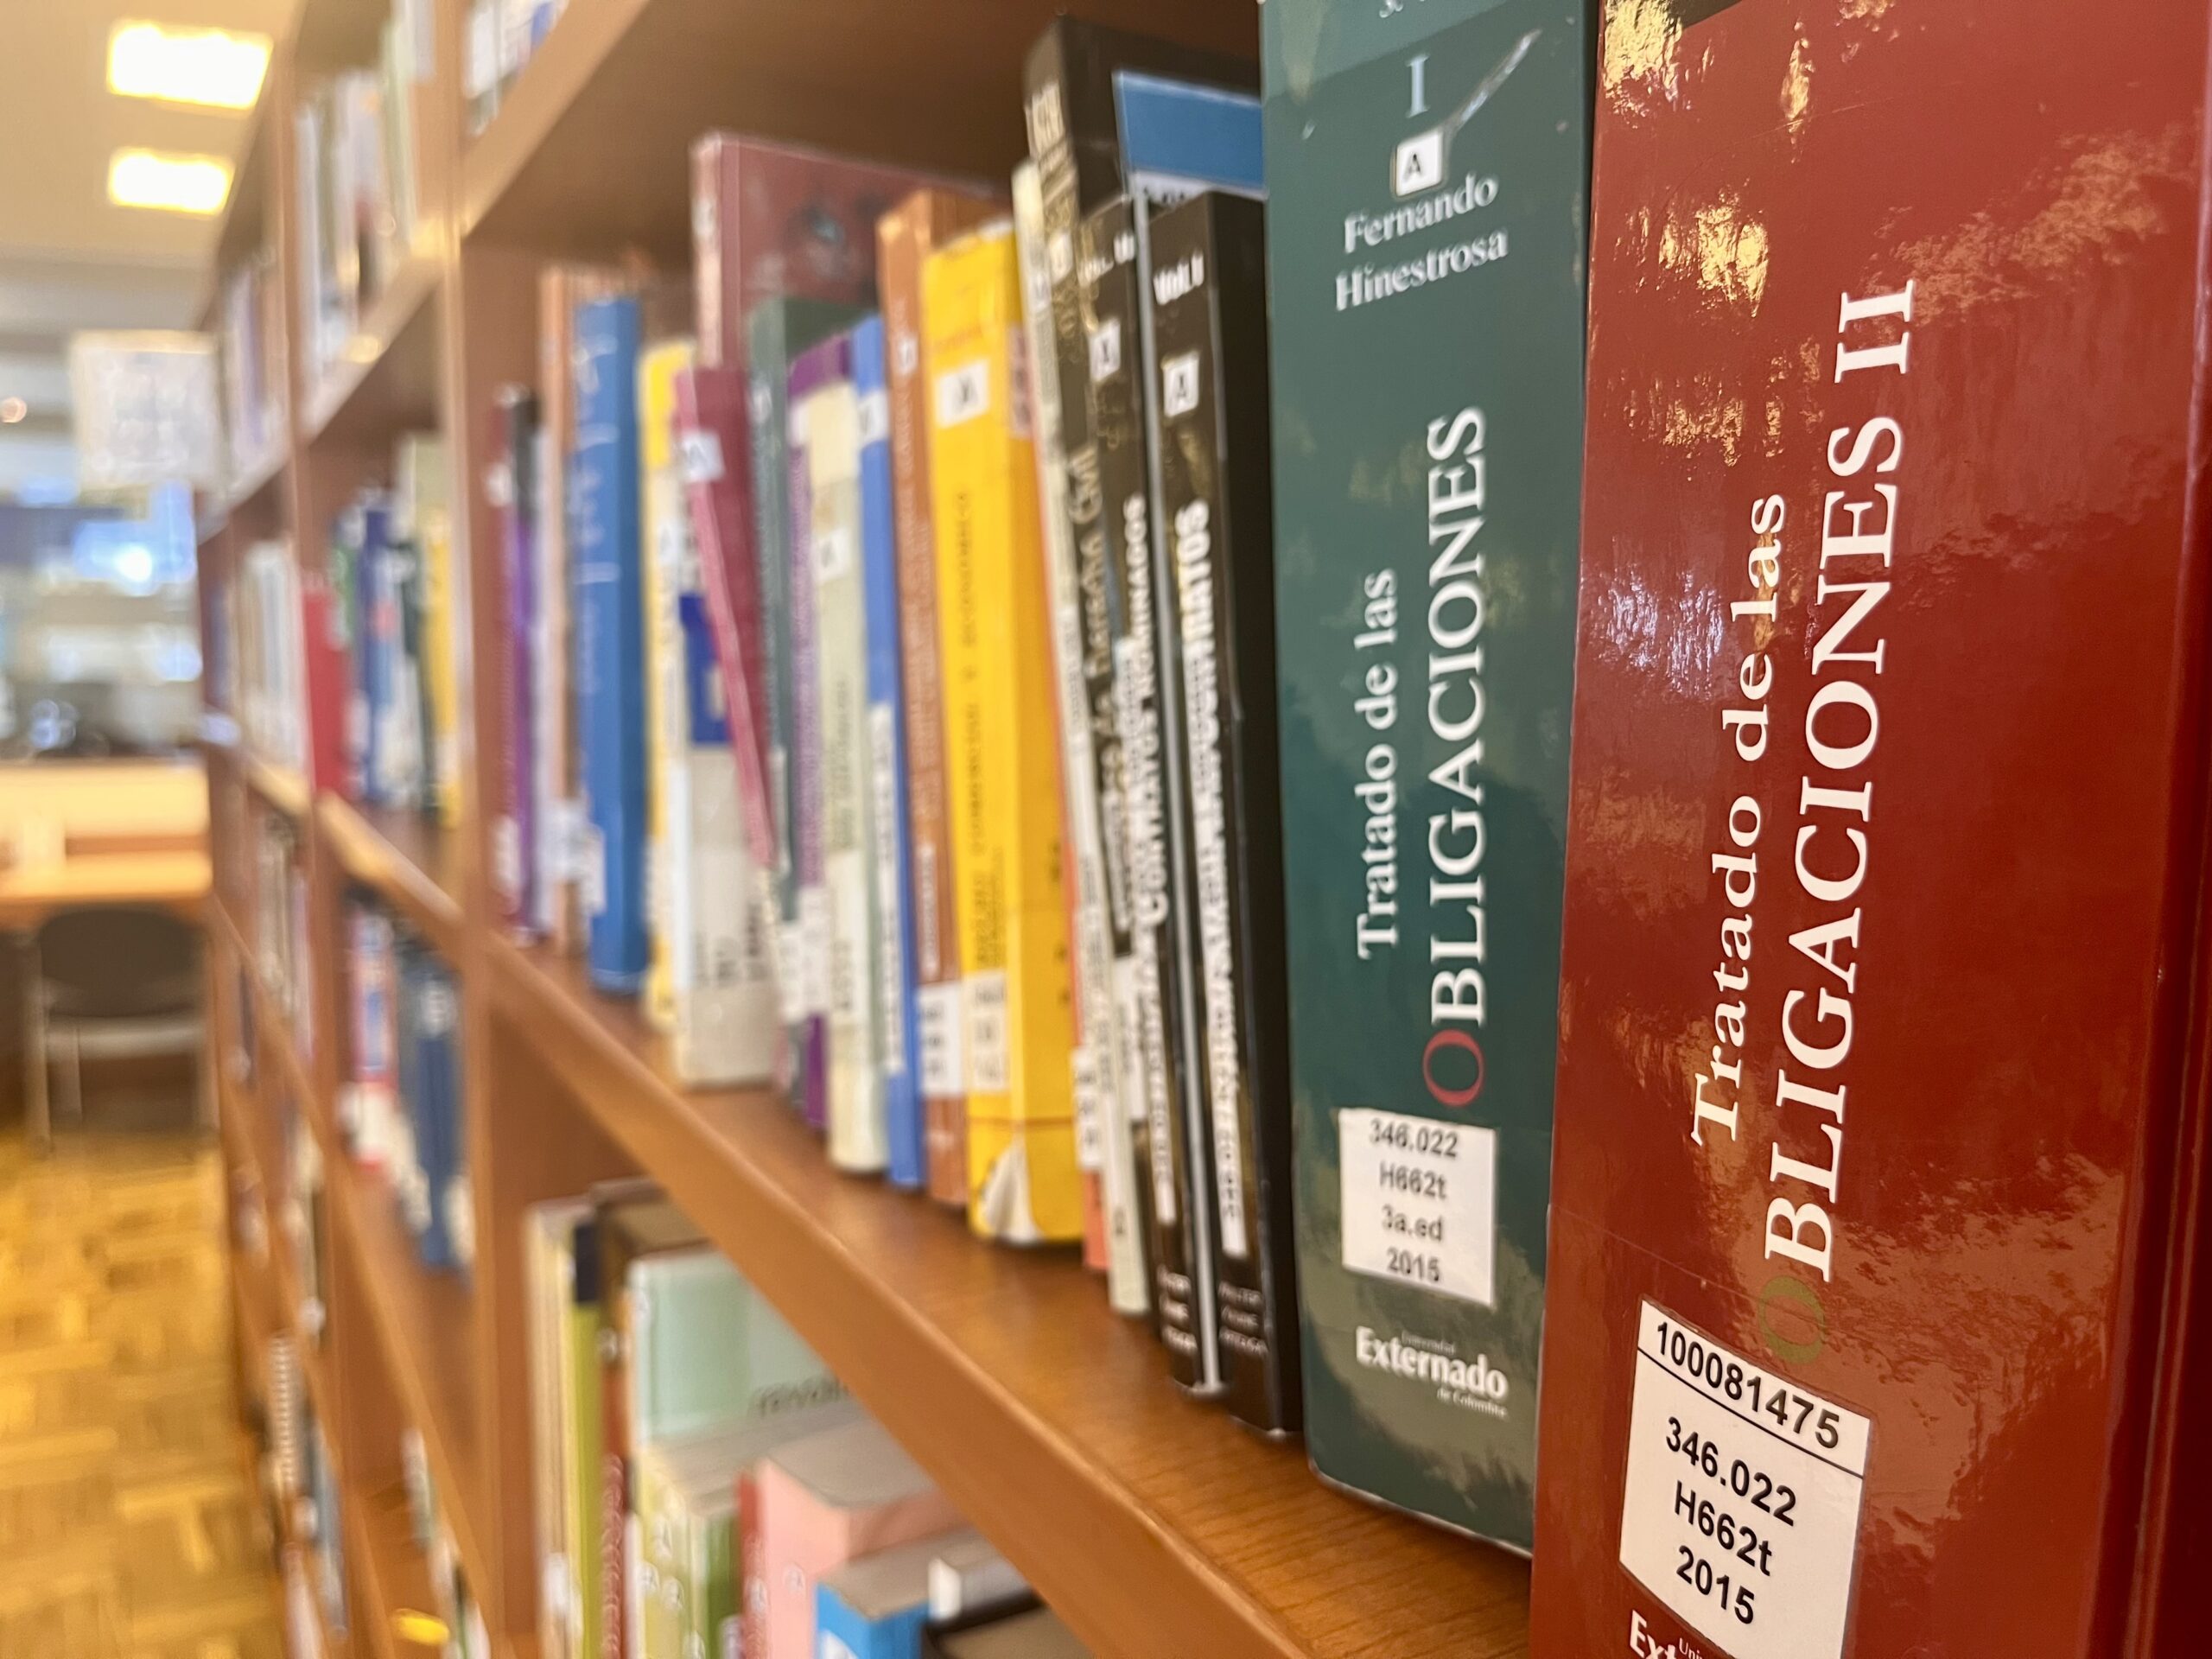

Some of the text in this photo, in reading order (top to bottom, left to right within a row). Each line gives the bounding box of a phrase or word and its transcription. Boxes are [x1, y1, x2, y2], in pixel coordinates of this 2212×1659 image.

[1407, 54, 1429, 118] I
[1403, 153, 1422, 183] A
[1344, 172, 1499, 255] Fernando
[1335, 227, 1510, 311] Hinestrosa
[1354, 568, 1399, 961] Tratado de las
[1421, 406, 1487, 1107] OBLIGACIONES
[1690, 493, 1786, 1147] Tratado de las
[1758, 278, 1916, 1365] OBLIGACIONES II
[1369, 1118, 1459, 1160] 346.022
[1379, 1162, 1448, 1200] H662t
[1381, 1205, 1443, 1243] 3a.ed
[1386, 1248, 1441, 1283] 2015
[1355, 1325, 1510, 1401] Externado
[1656, 1320, 1841, 1450] 100081475
[1665, 1416, 1798, 1527] 346.022
[1674, 1479, 1774, 1577] H662t
[1676, 1544, 1756, 1625] 2015
